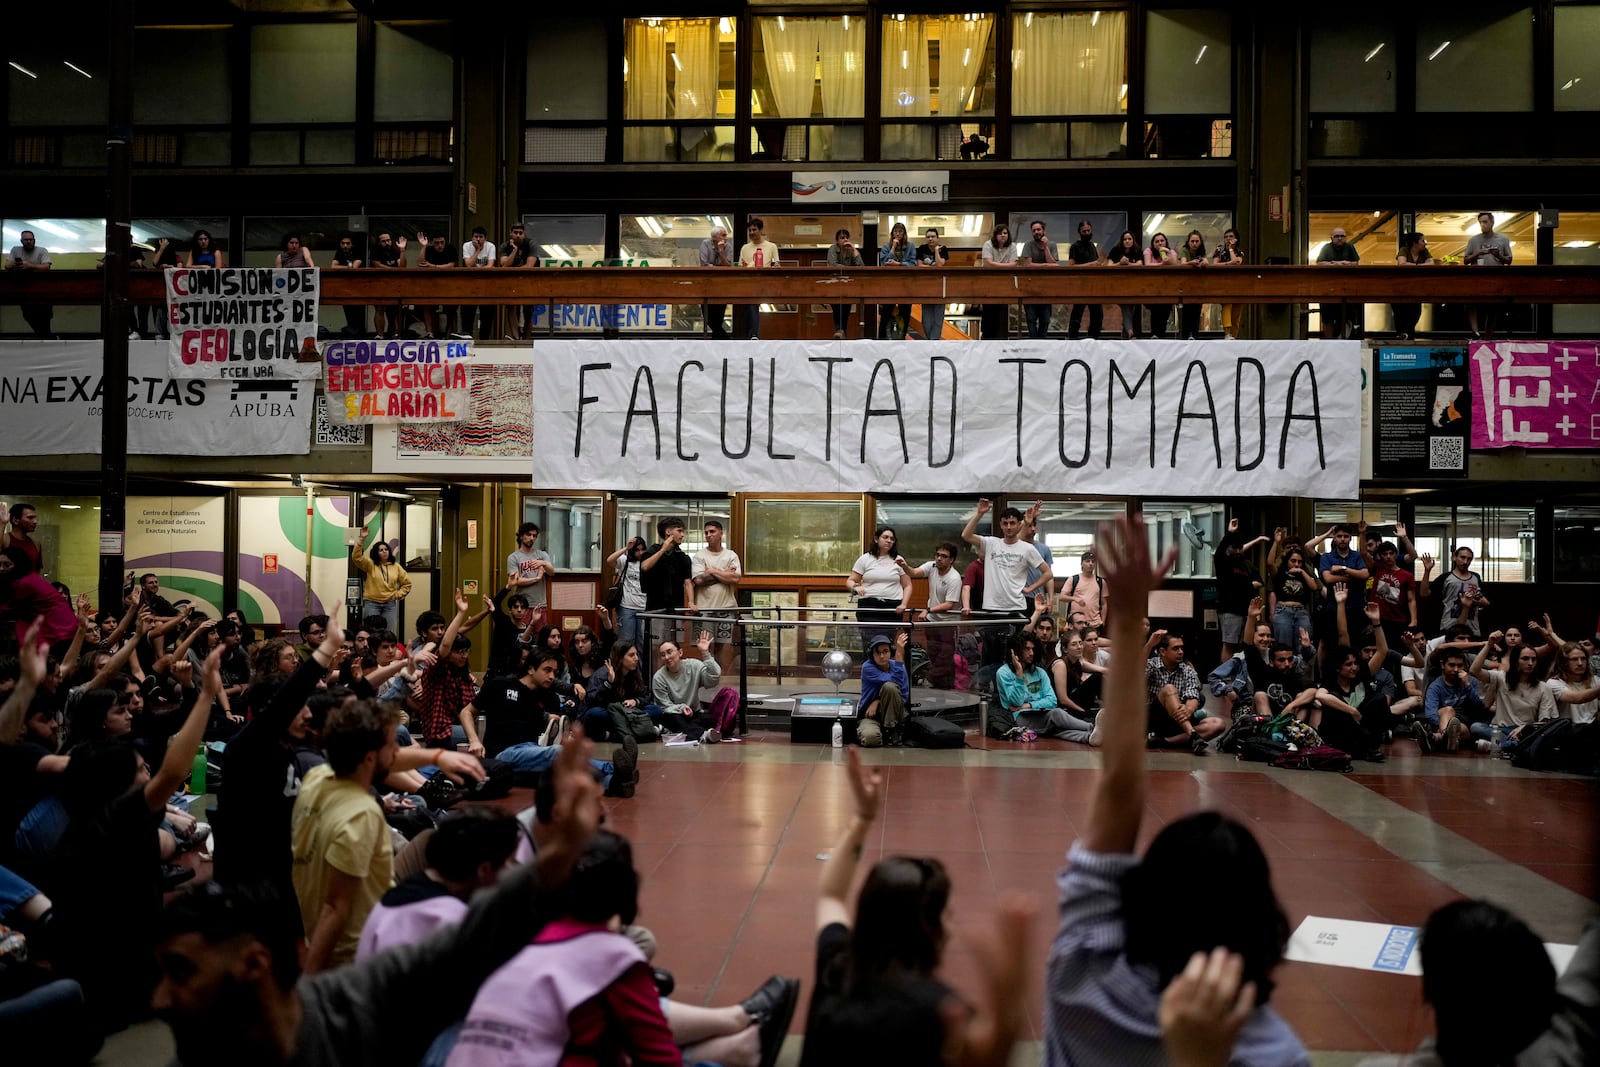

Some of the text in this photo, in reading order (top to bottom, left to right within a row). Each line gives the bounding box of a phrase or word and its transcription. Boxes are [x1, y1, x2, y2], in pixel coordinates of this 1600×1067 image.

[840, 184, 938, 195] CIENCIAS GEOLÓGICAS
[287, 268, 315, 294] DE
[170, 298, 315, 325] ESTUDIANTES DE
[532, 303, 667, 327] PERMANENTE
[181, 325, 299, 365] GEOLOGÍA
[447, 342, 467, 358] EN
[1383, 352, 1390, 360] La
[220, 366, 274, 378] FCEN UBA
[1495, 343, 1552, 443] FEM
[127, 407, 175, 421] DOCENTE
[228, 403, 296, 417] APUBA
[574, 356, 1326, 472] FACULTAD TOMADA
[169, 509, 201, 517] Estudiantes
[183, 518, 206, 526] Ciencias
